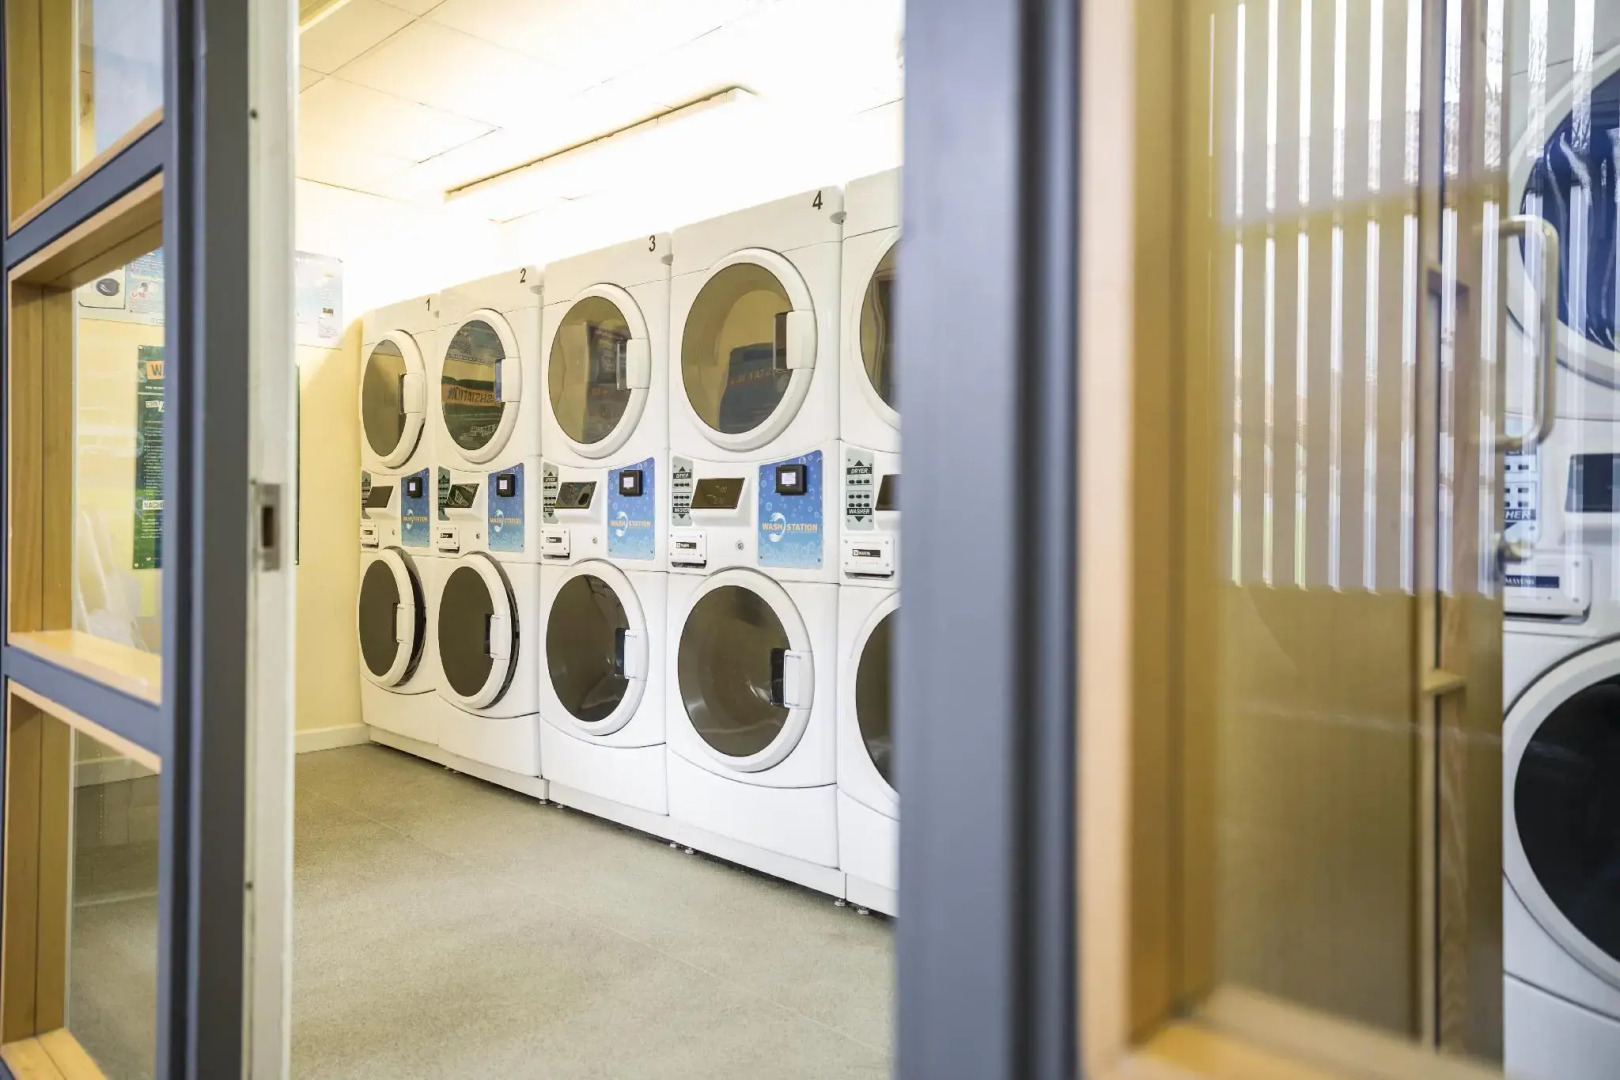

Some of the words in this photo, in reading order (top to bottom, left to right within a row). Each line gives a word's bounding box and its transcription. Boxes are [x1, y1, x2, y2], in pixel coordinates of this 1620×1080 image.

[812, 190, 823, 210] 4
[649, 235, 656, 252] 3
[520, 267, 527, 283] 2
[426, 298, 431, 311] 1
[611, 520, 626, 528] WASH
[762, 522, 783, 531] WASH
[787, 523, 817, 531] STATION
